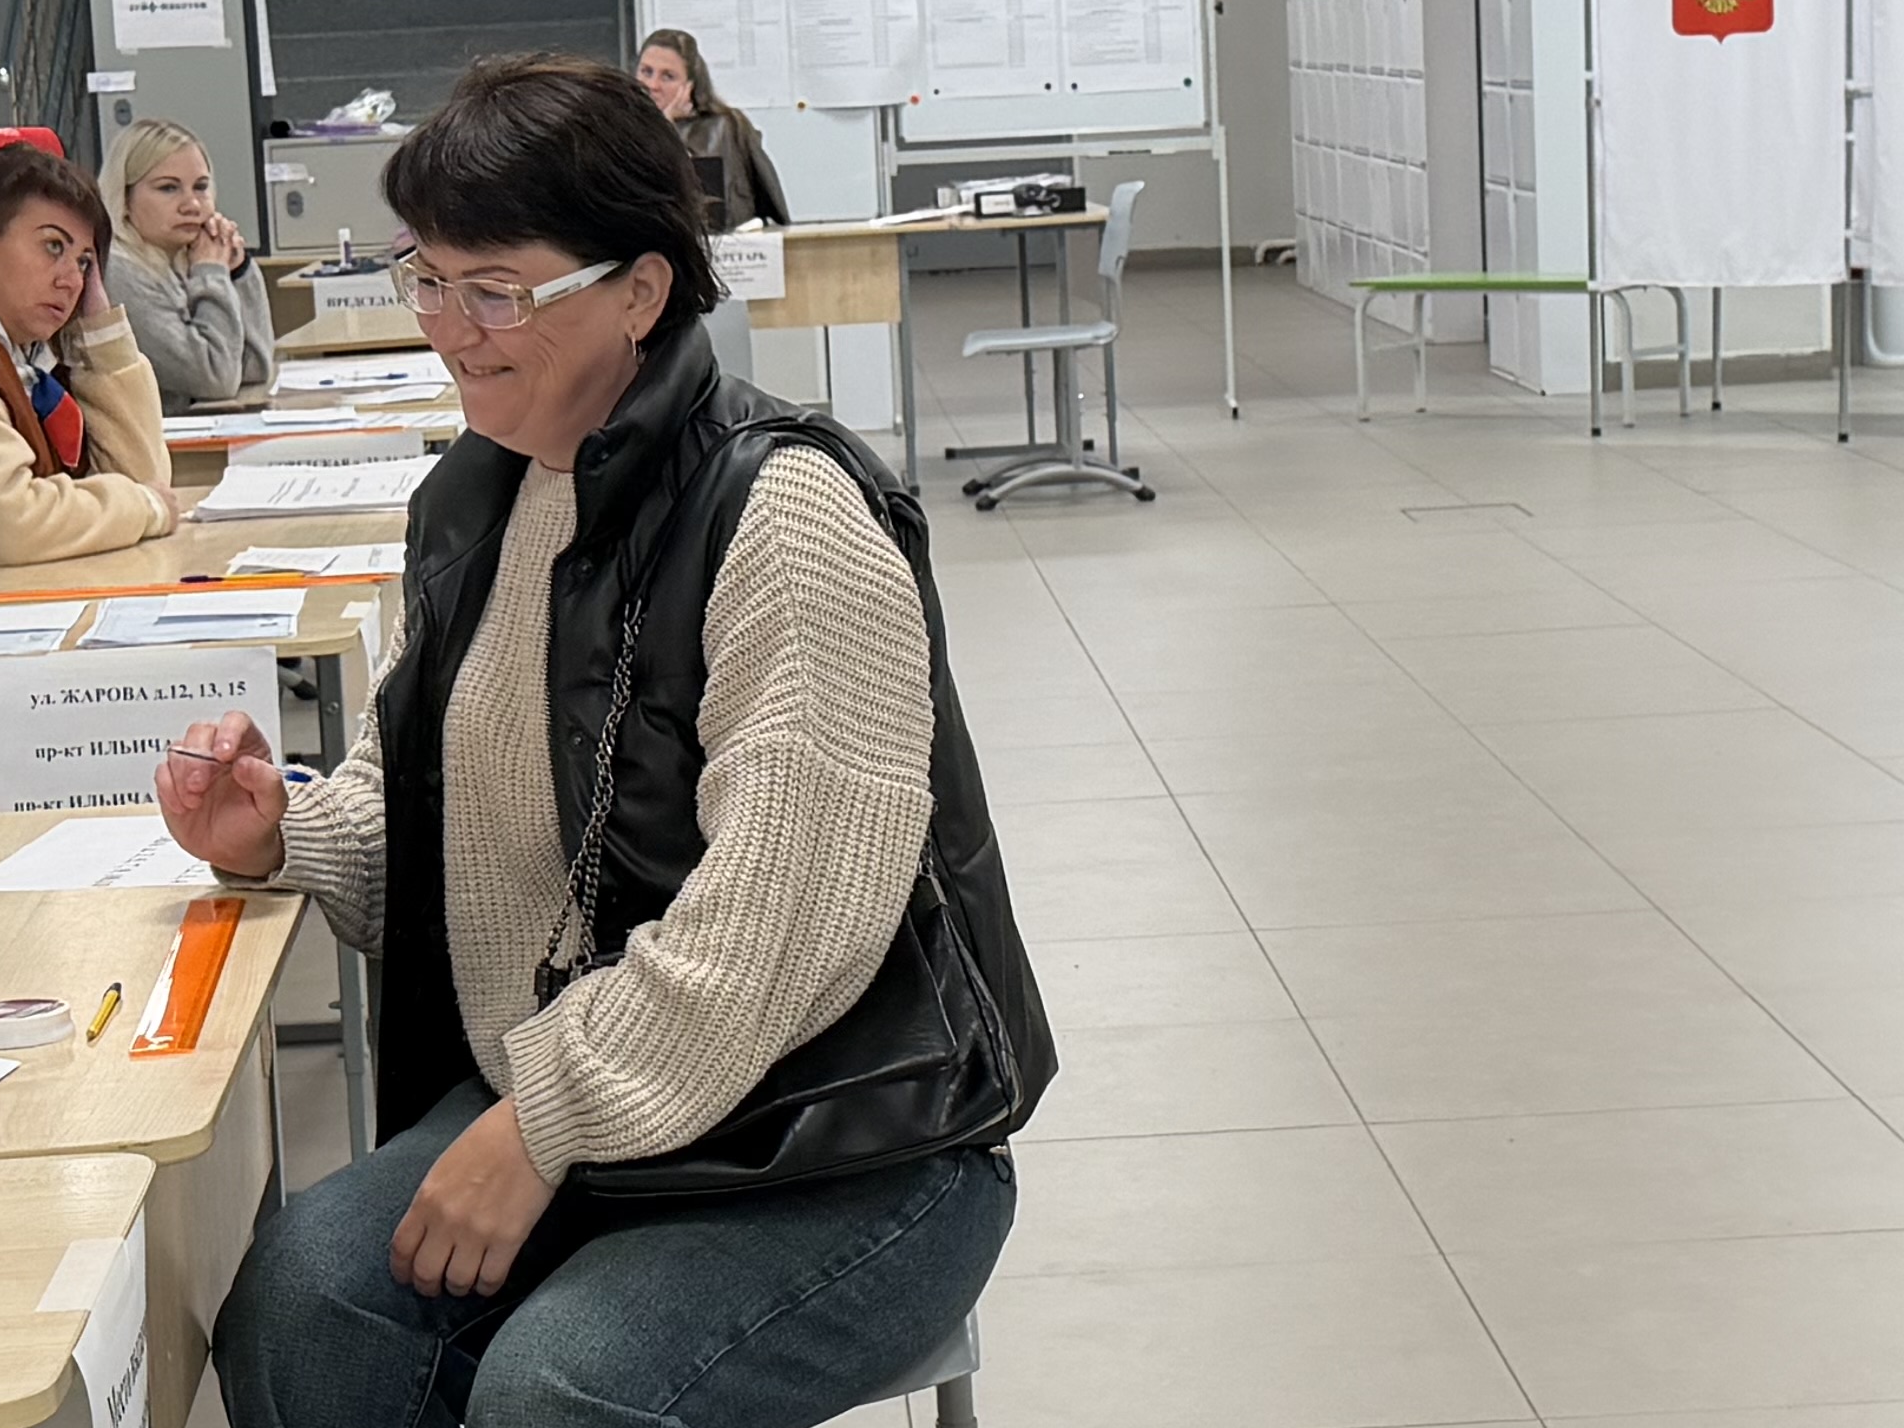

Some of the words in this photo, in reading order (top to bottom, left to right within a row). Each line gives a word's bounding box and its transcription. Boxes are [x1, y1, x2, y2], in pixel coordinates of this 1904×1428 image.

[30, 693, 56, 710] ул.
[60, 685, 148, 704] ЖАРОВА
[153, 683, 194, 703] д.12,
[200, 682, 223, 700] 13,
[228, 681, 247, 697] 15
[35, 746, 84, 763] пр-кт
